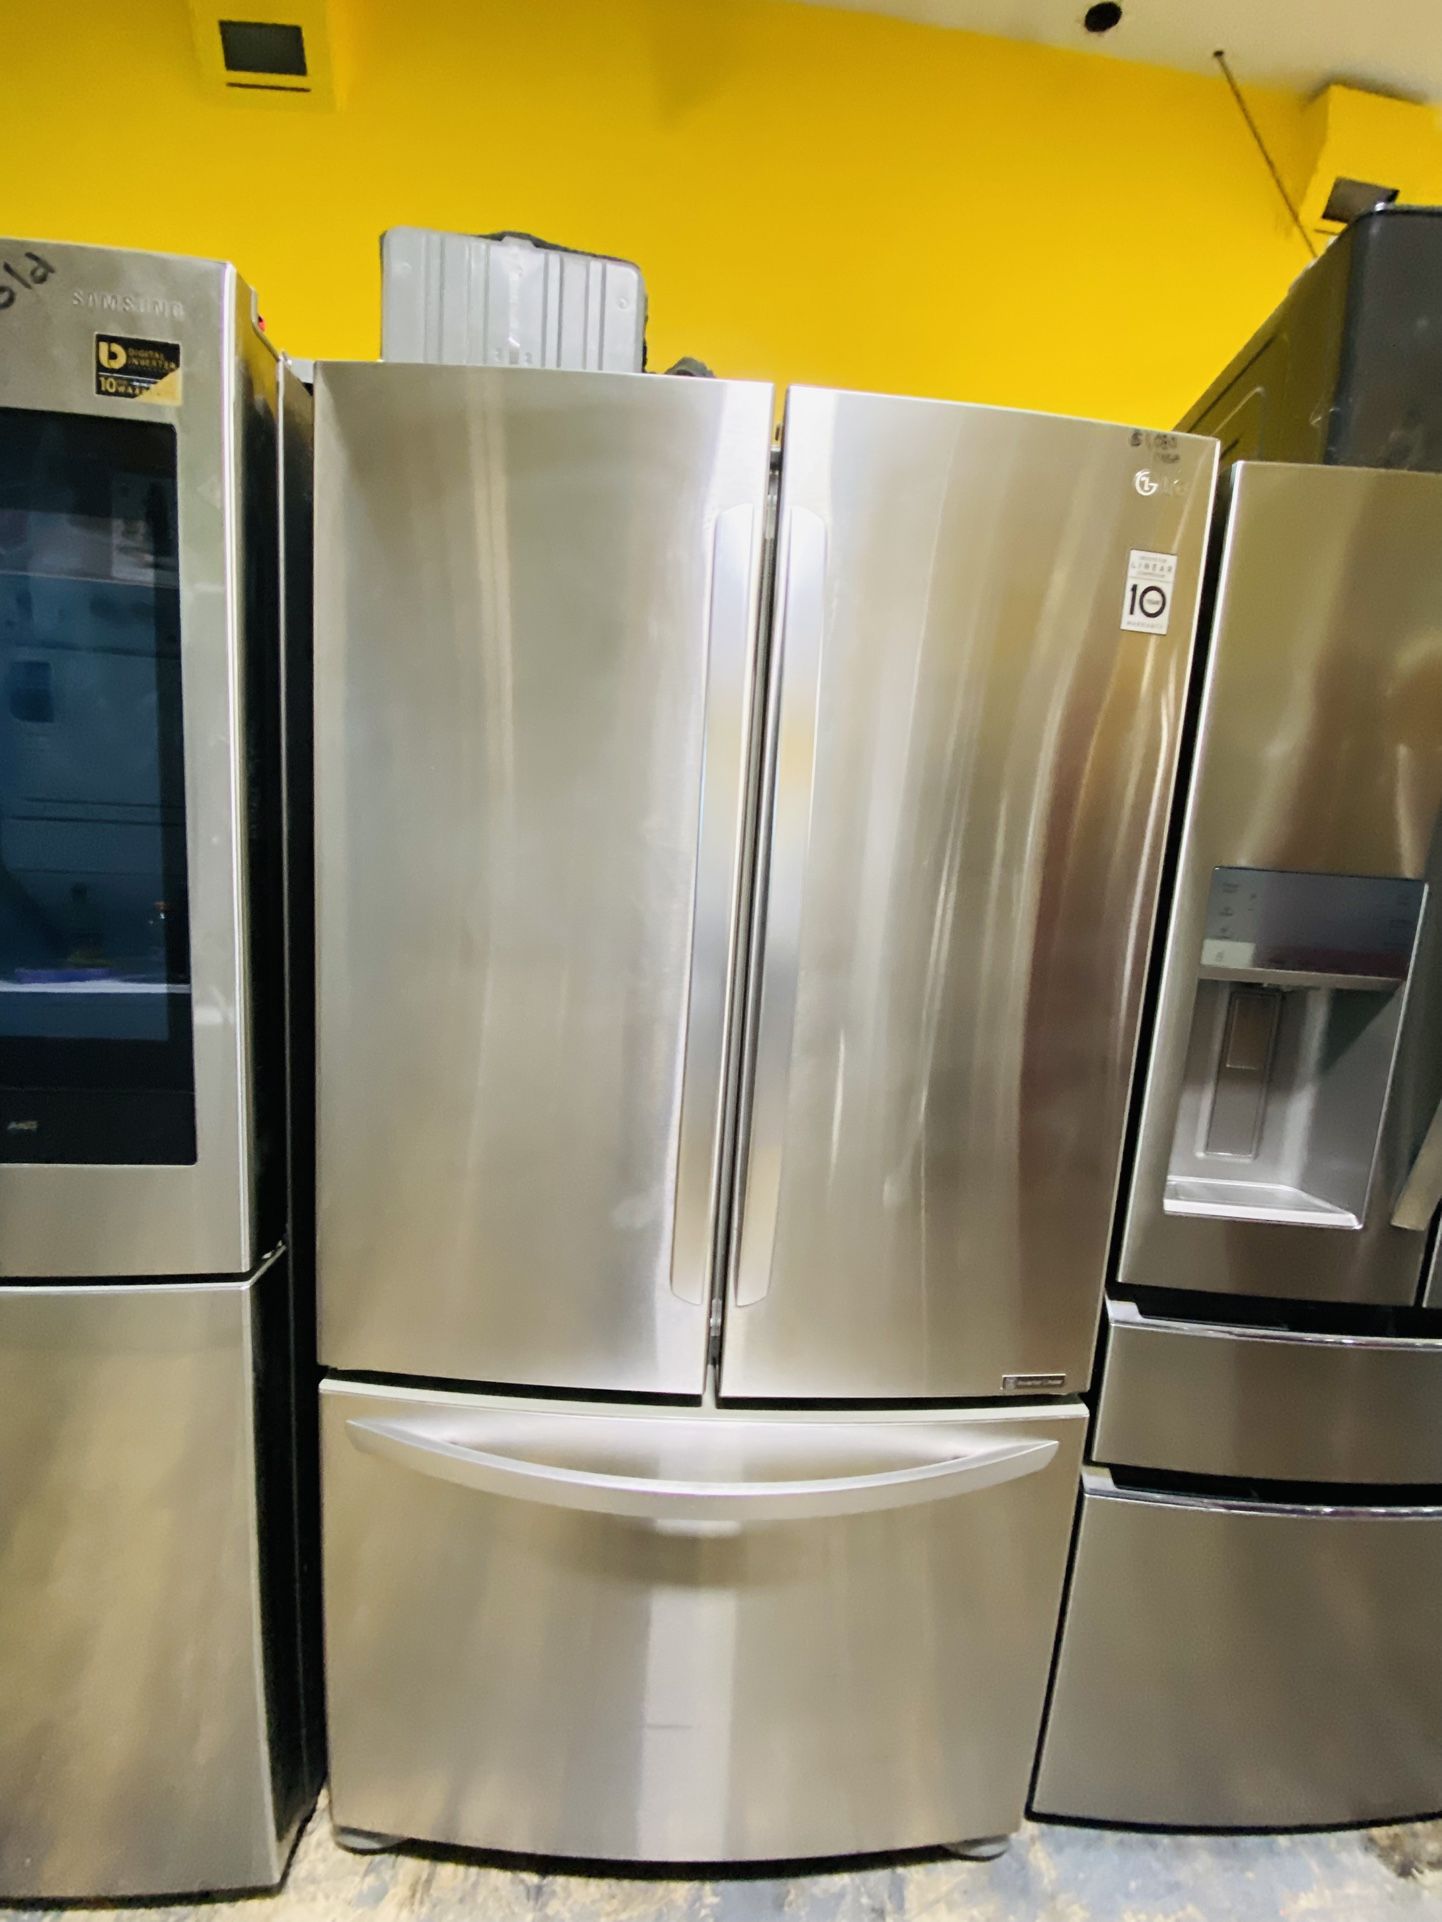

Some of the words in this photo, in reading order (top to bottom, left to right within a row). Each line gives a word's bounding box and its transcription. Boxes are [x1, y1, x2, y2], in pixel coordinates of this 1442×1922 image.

[73, 290, 186, 321] SAMSUNG
[99, 377, 117, 393] 10
[1129, 584, 1167, 619] 10
